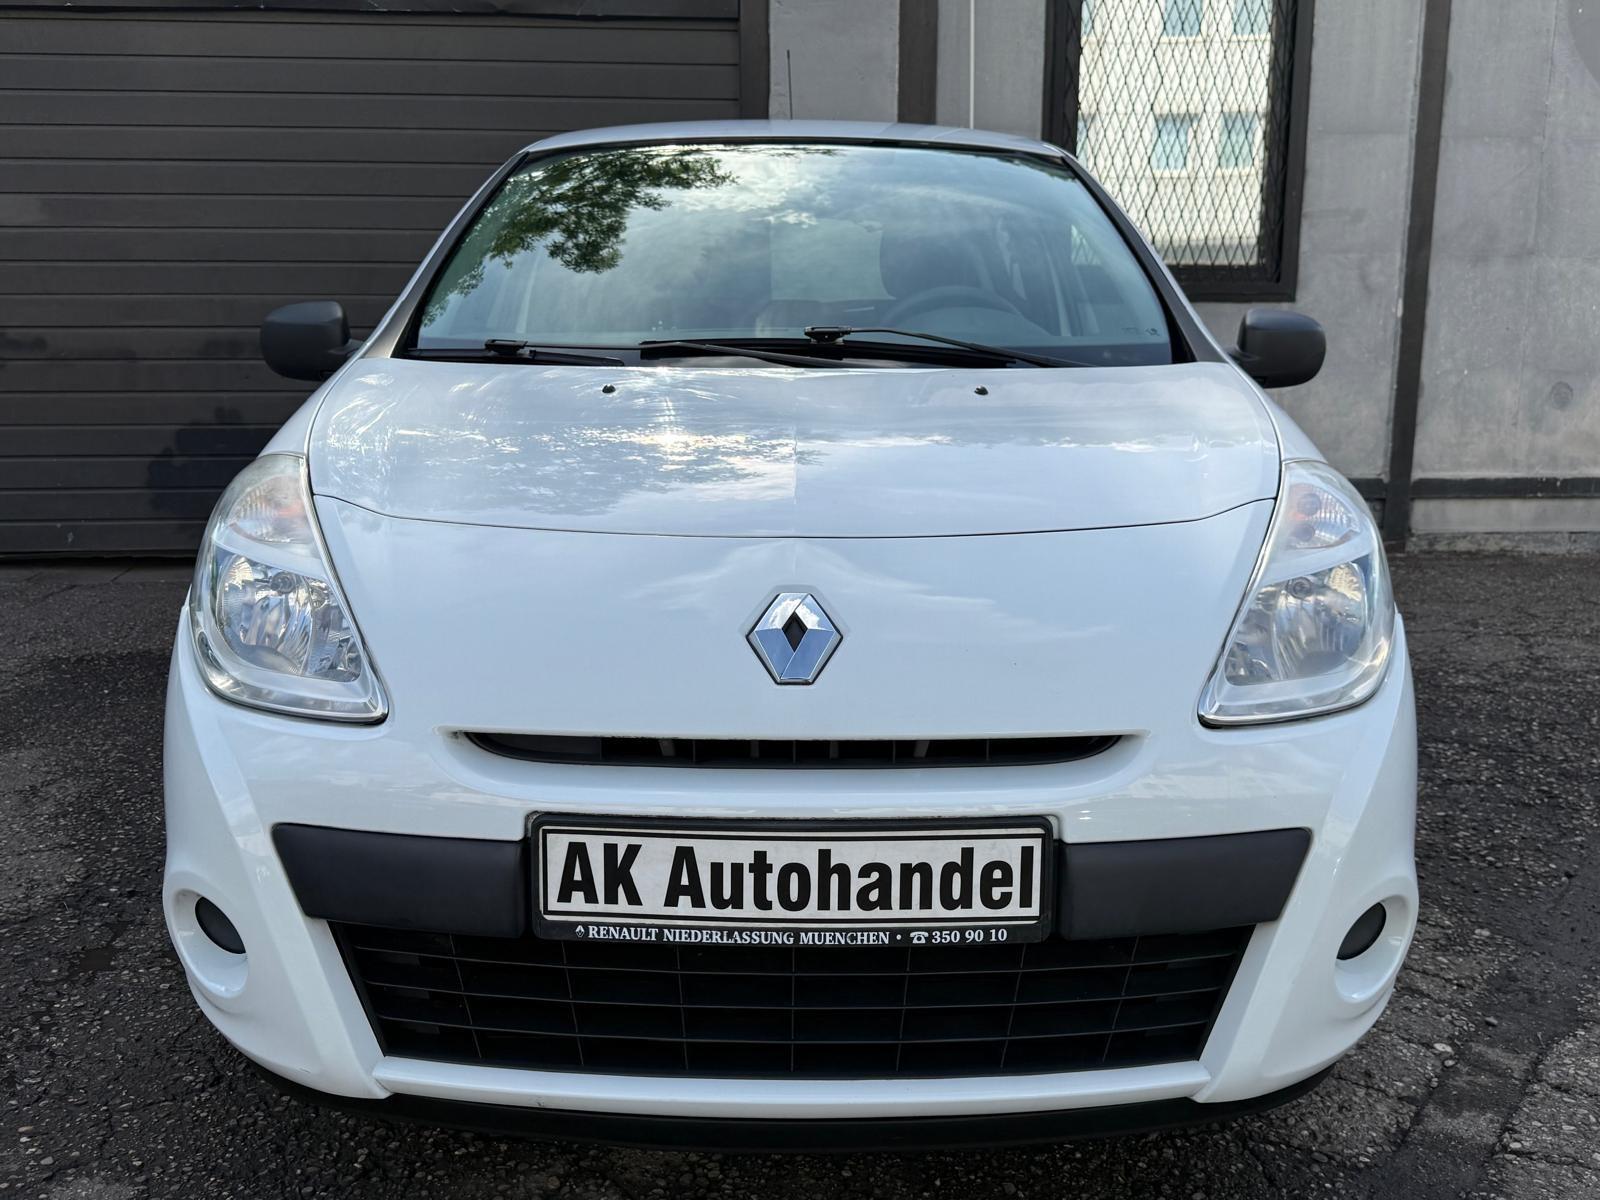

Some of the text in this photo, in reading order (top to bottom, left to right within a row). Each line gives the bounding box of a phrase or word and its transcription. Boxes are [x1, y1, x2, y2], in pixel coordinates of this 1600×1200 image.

[556, 841, 1035, 912] AK Autohandel
[587, 925, 1008, 945] RENAULT NIEDERLASSUNG MUENCHEN 350 90 10
